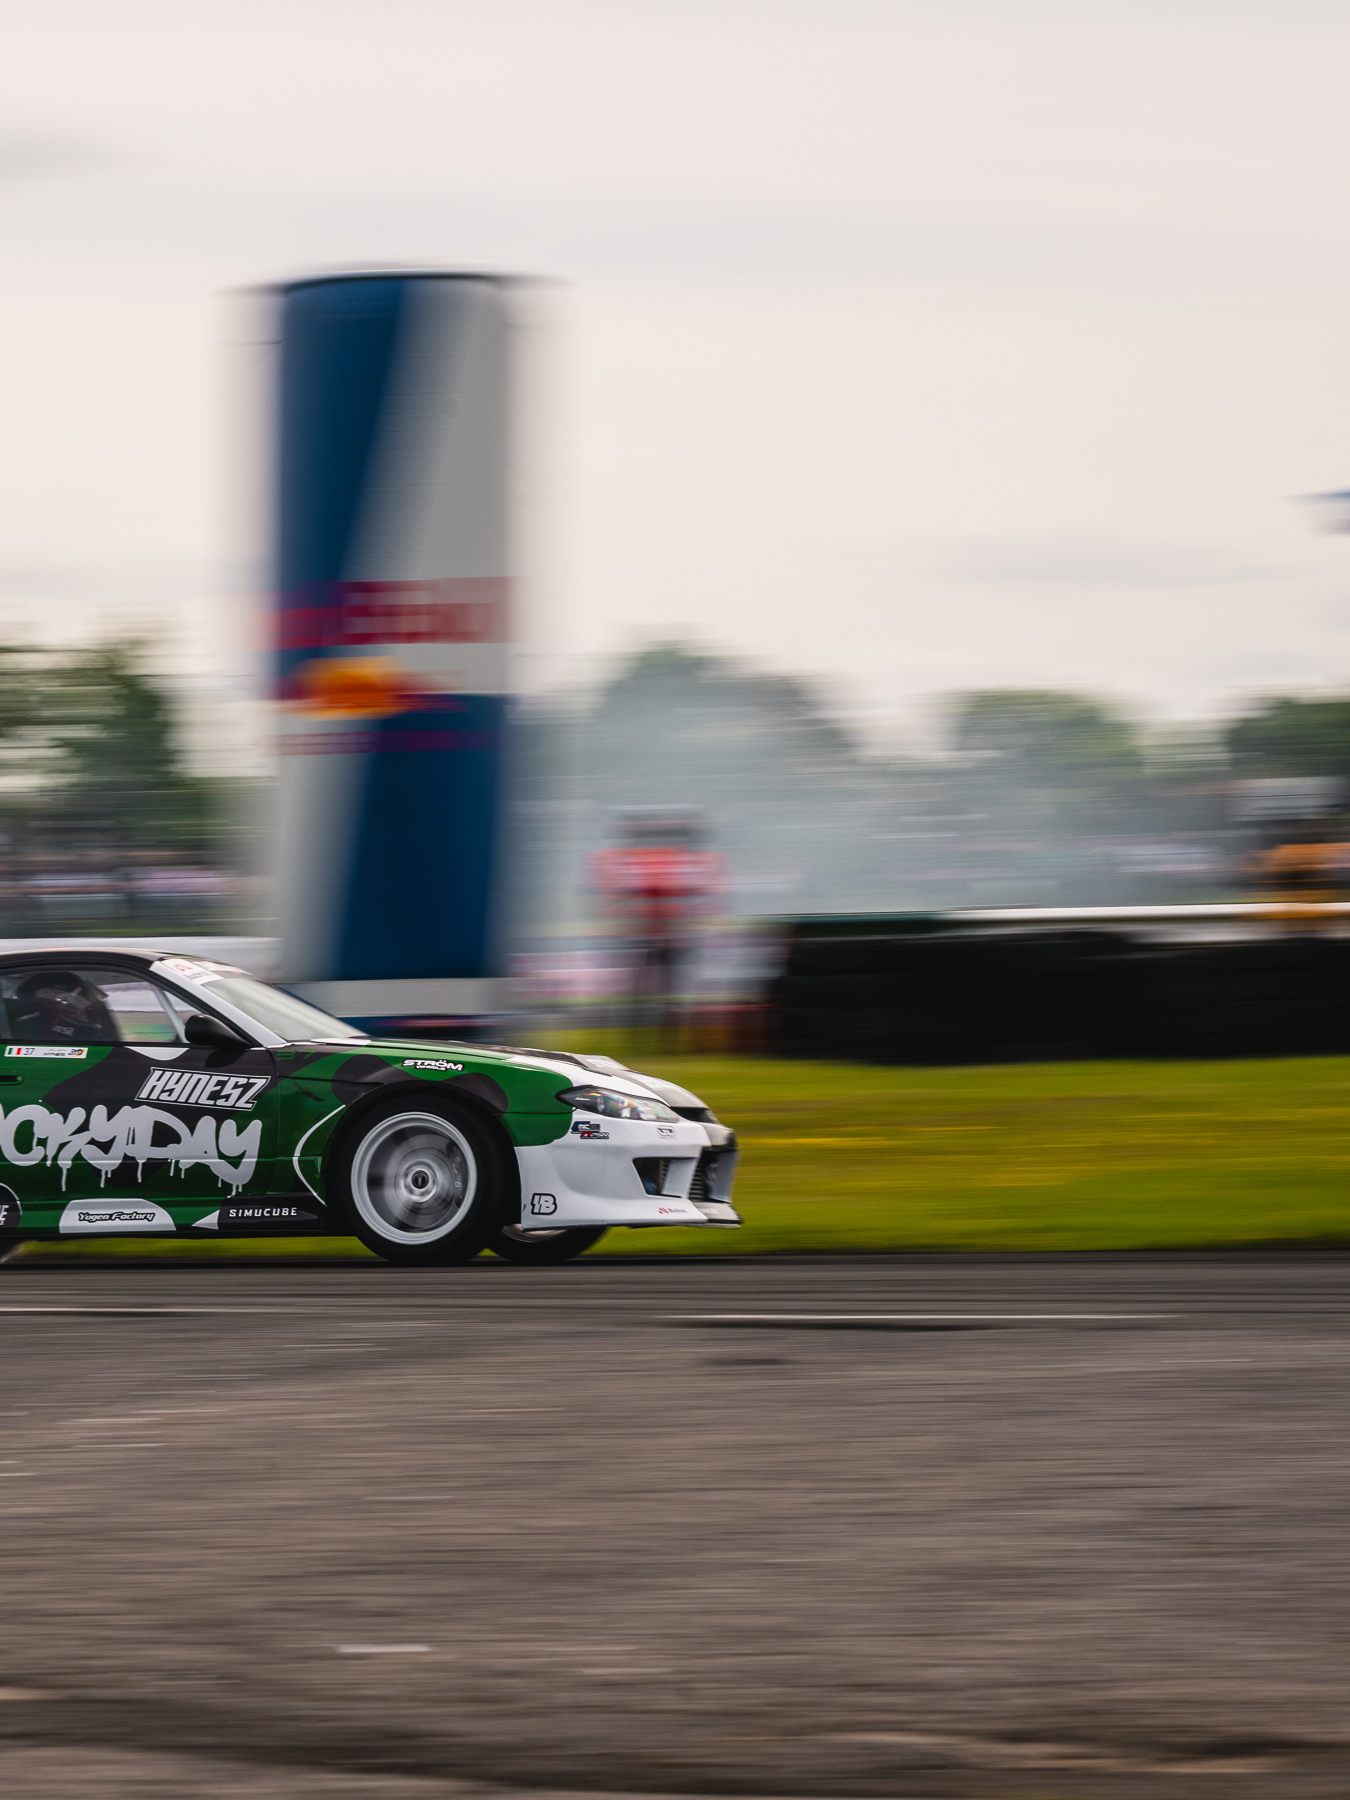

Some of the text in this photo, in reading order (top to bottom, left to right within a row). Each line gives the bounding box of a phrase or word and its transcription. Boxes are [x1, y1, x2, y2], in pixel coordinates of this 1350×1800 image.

[402, 1059, 463, 1071] STRÖM
[138, 1068, 268, 1109] HYNESZ
[78, 1211, 155, 1223] Yugen Factory
[228, 1207, 298, 1217] SIMUCUBE
